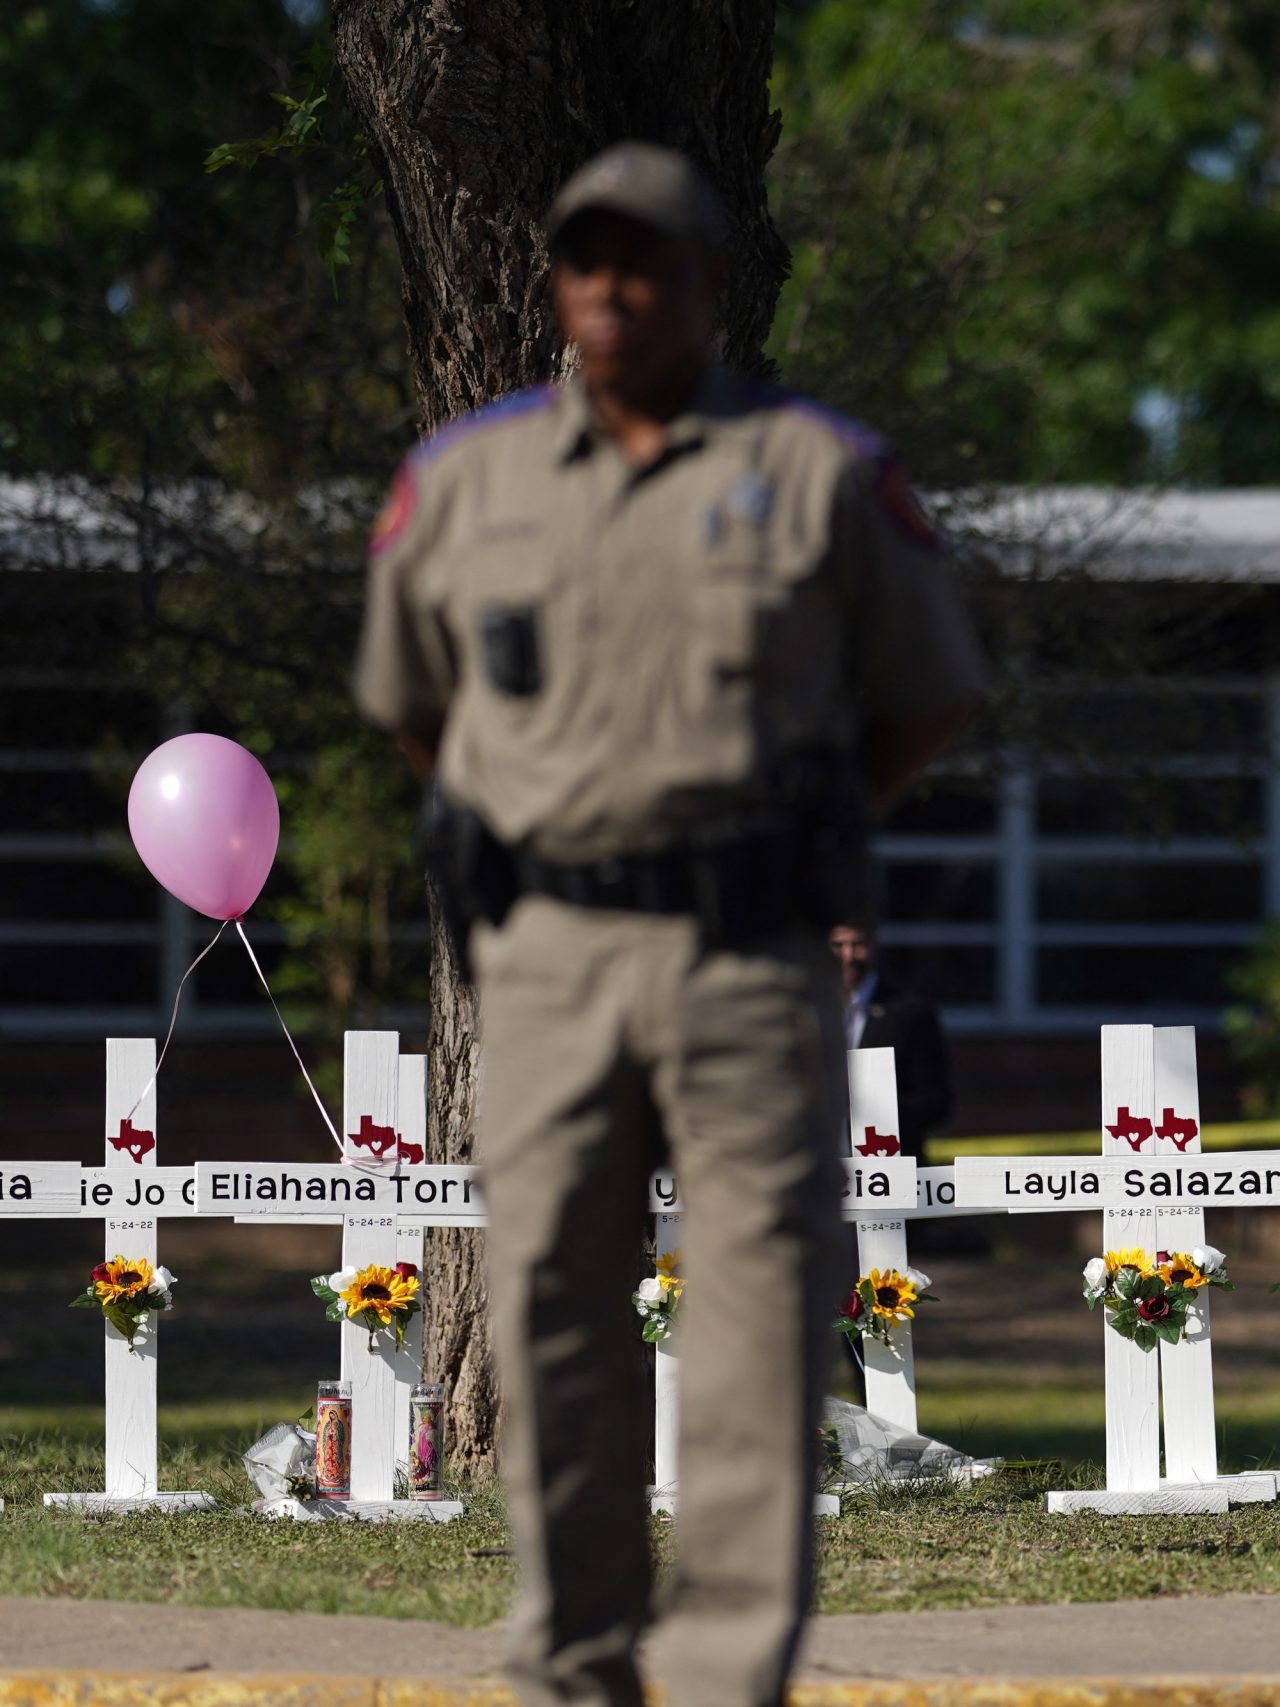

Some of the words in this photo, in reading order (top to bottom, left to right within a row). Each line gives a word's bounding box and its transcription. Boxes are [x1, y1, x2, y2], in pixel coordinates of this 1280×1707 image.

[211, 1173, 376, 1201] Eliahana
[1005, 1170, 1099, 1201] Layla
[81, 1179, 113, 1206] ie
[125, 1178, 165, 1206] Jo
[917, 1180, 955, 1206] lo
[1108, 1208, 1152, 1218] 5-24-22
[1158, 1207, 1200, 1217] 5-24-22
[109, 1221, 153, 1230] 5-24-22
[348, 1218, 393, 1227] 5-24-22
[860, 1222, 902, 1232] 5-24-22
